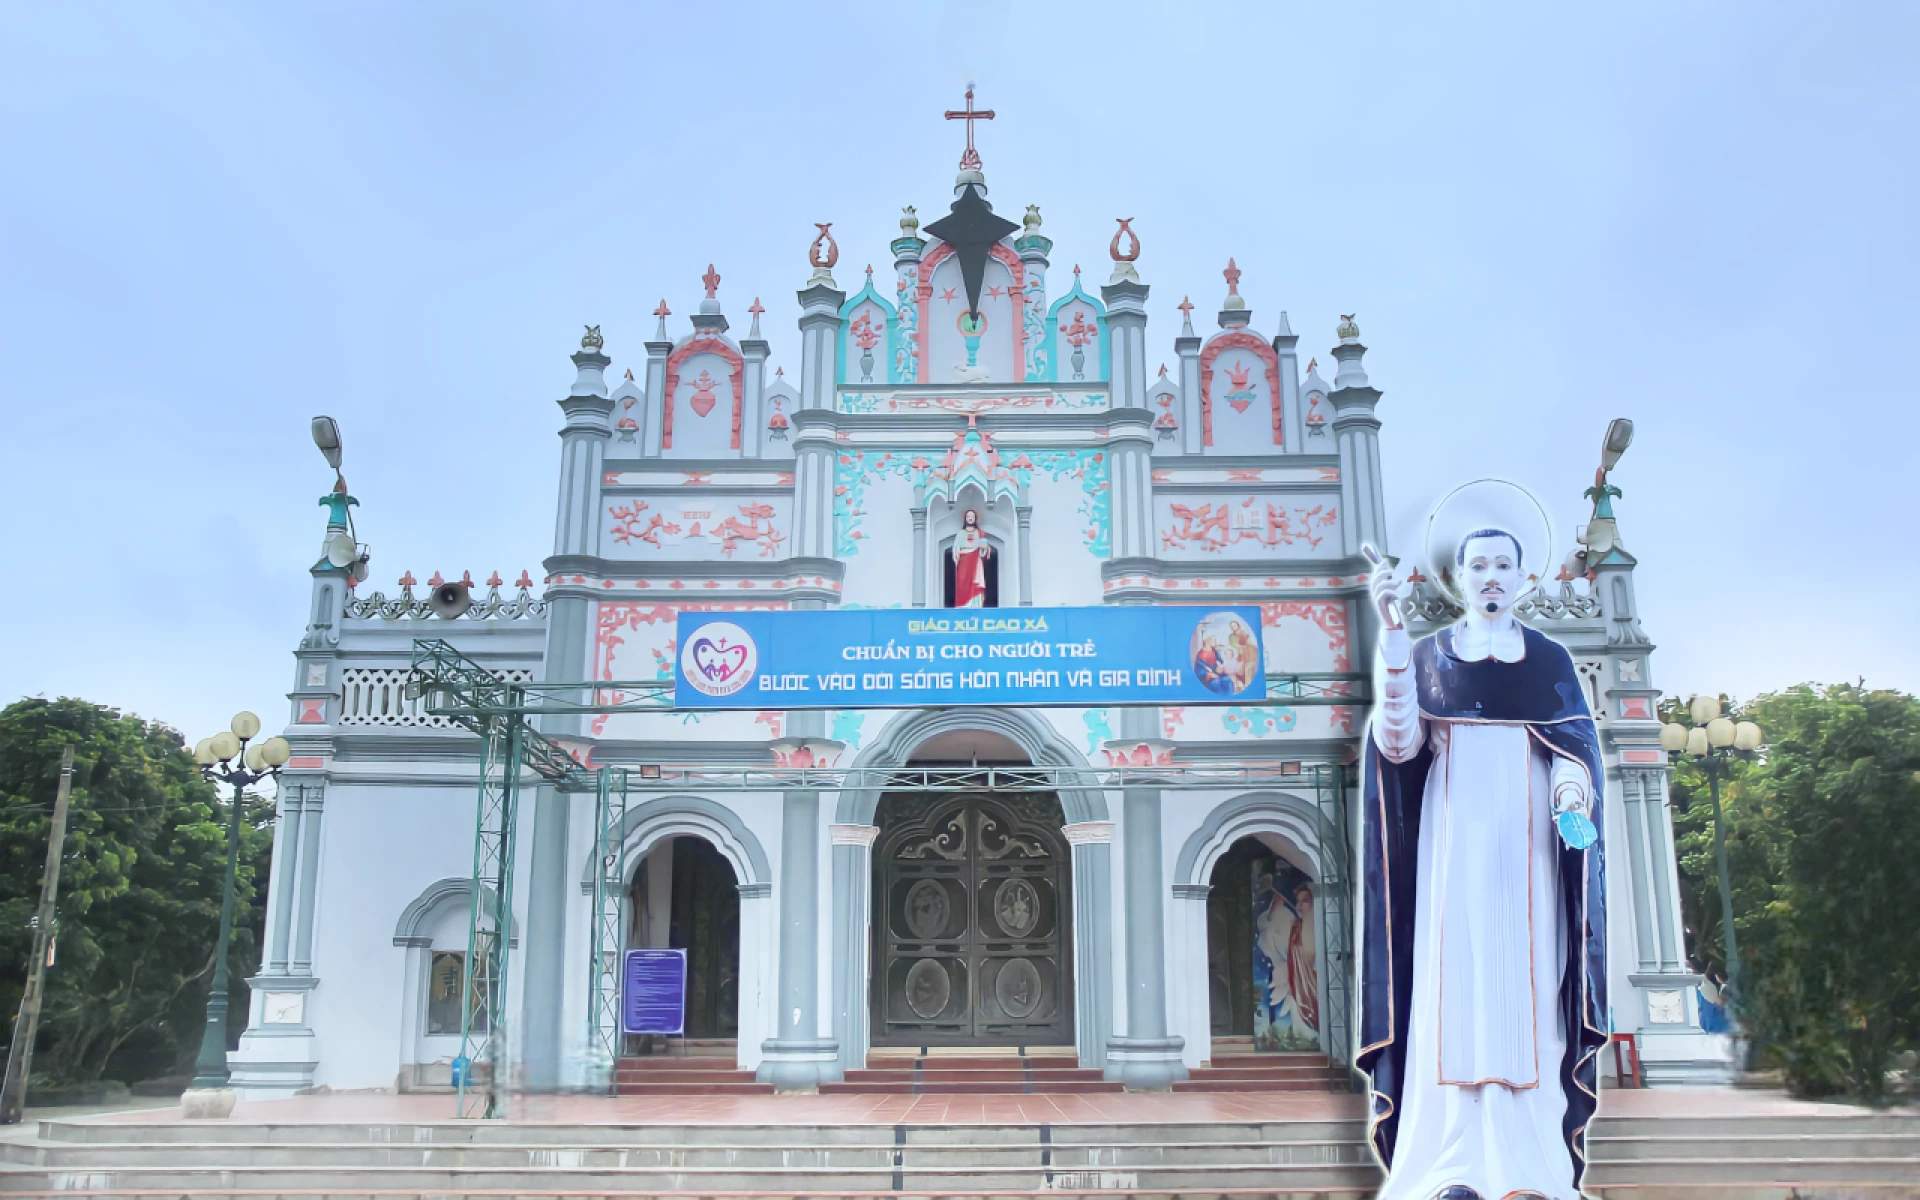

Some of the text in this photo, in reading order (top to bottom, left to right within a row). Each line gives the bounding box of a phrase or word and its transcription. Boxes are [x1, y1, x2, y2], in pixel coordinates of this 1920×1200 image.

[982, 619, 1021, 631] CAO
[915, 645, 935, 662] BỊ
[940, 644, 983, 659] CHO
[988, 640, 1051, 658] NGƯỜI
[1055, 638, 1097, 658] TRẺ
[1098, 669, 1130, 687] GIA
